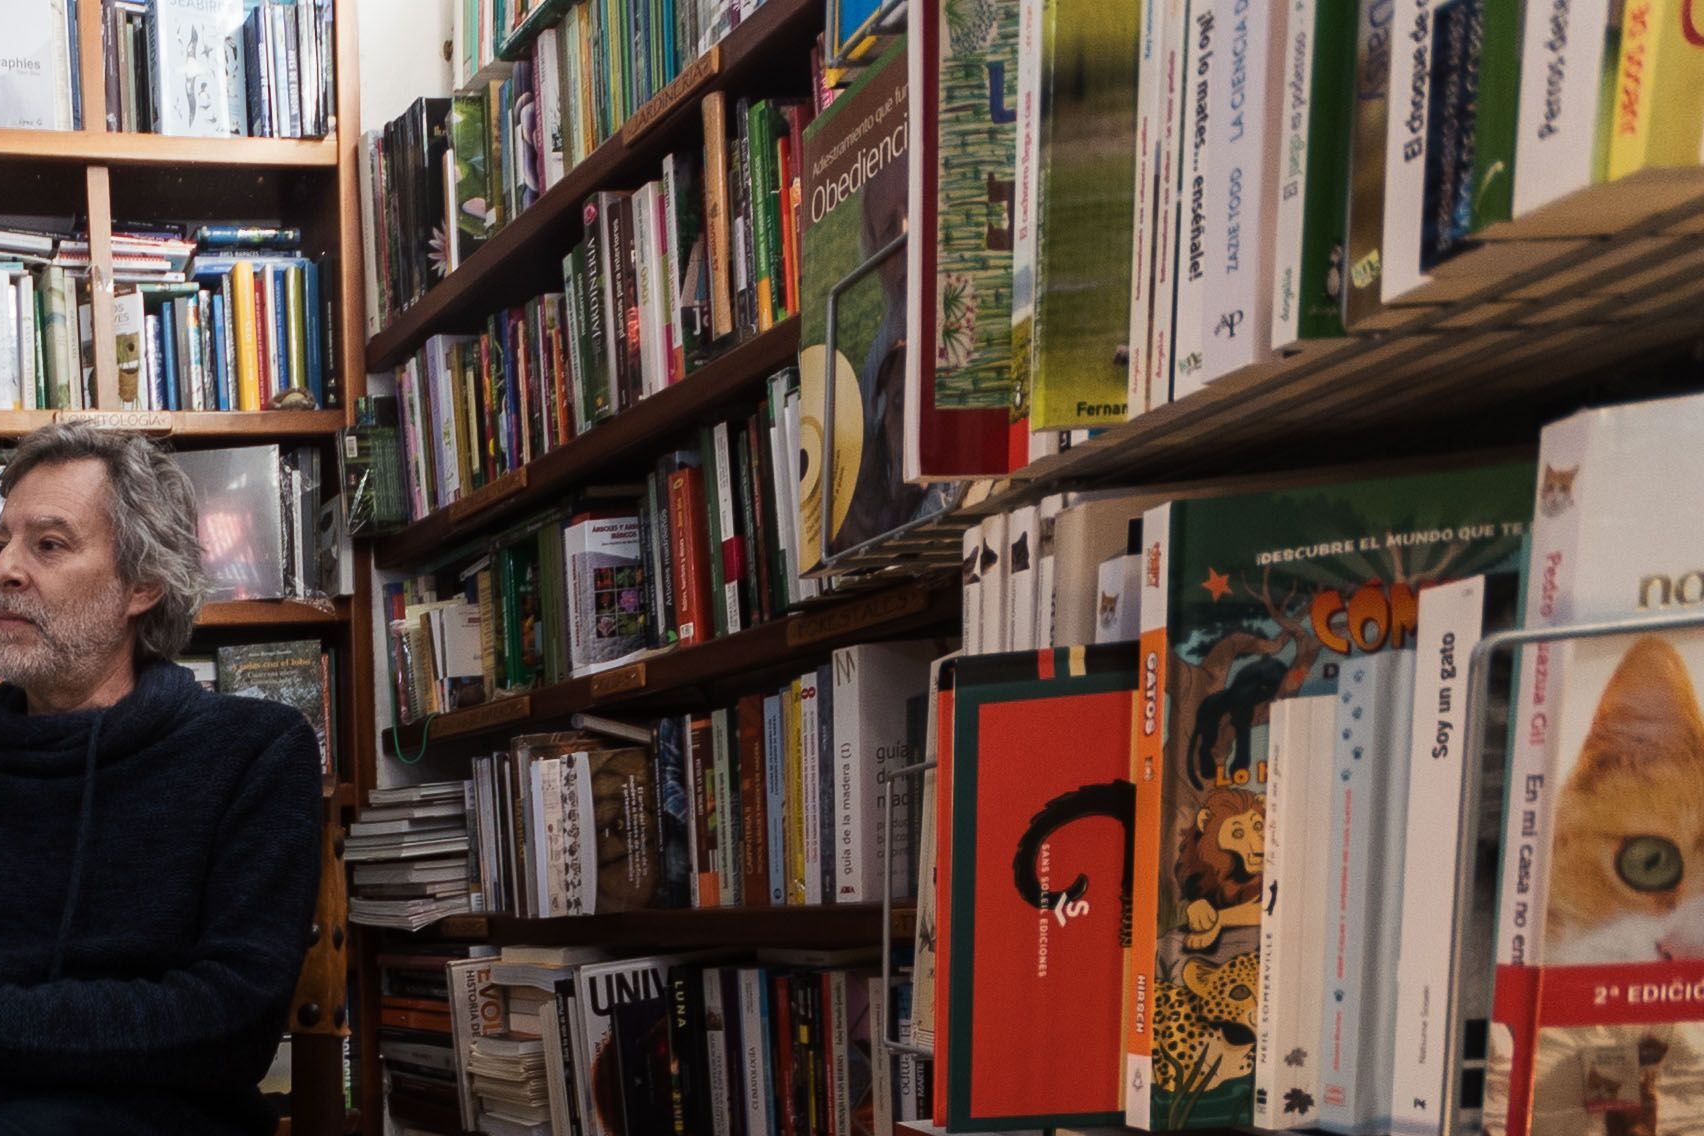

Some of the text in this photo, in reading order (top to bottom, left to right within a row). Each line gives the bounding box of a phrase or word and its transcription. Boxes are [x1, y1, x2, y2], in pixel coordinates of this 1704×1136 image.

[1287, 31, 1307, 110] poderoso
[1403, 11, 1431, 163] El choque de
[1536, 56, 1565, 140] Perros
[1225, 18, 1249, 273] ZAZIE TODD LA CIENCIA
[1019, 165, 1032, 224] cachorro
[1187, 175, 1204, 281] enséñale!
[1256, 521, 1524, 566] ¡DESCUBRE EL MUNDO QUE TE
[1528, 551, 1564, 746] Pedro Gil
[1142, 650, 1160, 737] GATOS
[1430, 632, 1459, 760] Soy un gato
[840, 763, 853, 875] guía madera
[1514, 772, 1546, 928] En mi casa no
[1038, 844, 1050, 977] SANS SOLEIL EDICIONES
[465, 969, 481, 1024] HISTORIA
[674, 980, 686, 1029] LUNA
[1134, 973, 1147, 1035] HIRSCH
[1261, 931, 1277, 1017] SOMERVILLE
